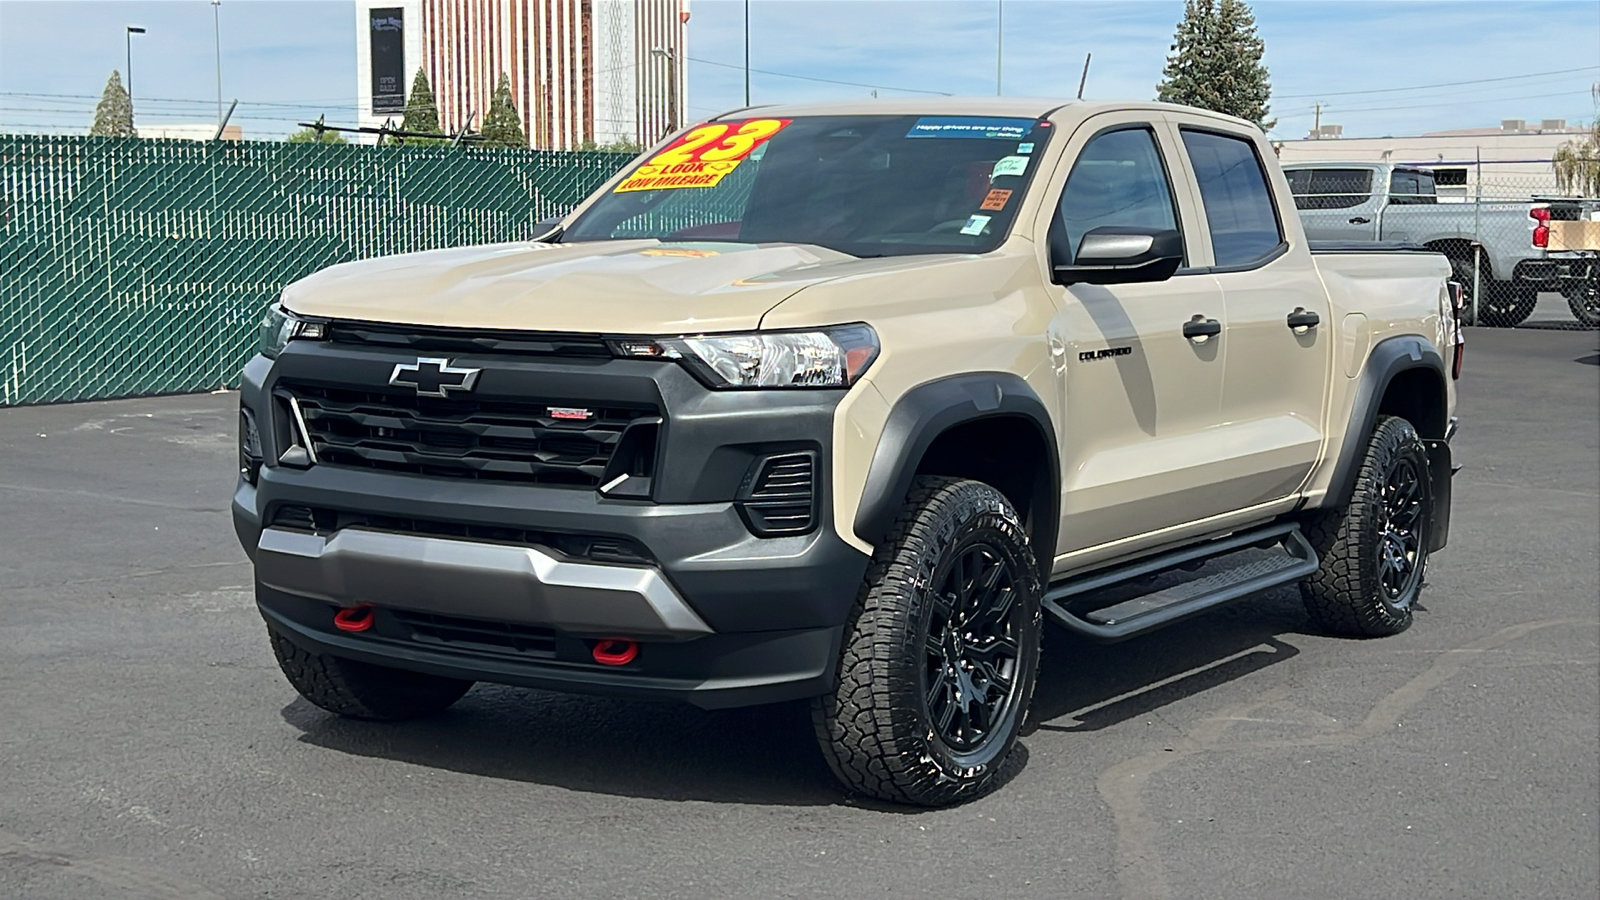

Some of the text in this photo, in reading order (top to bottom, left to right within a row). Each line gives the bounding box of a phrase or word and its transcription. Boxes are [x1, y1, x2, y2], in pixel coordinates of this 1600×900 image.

[648, 119, 782, 166] 23
[659, 162, 710, 175] LOOK
[620, 173, 719, 190] LOW MILEAGE
[1079, 346, 1132, 361] COLORADO
